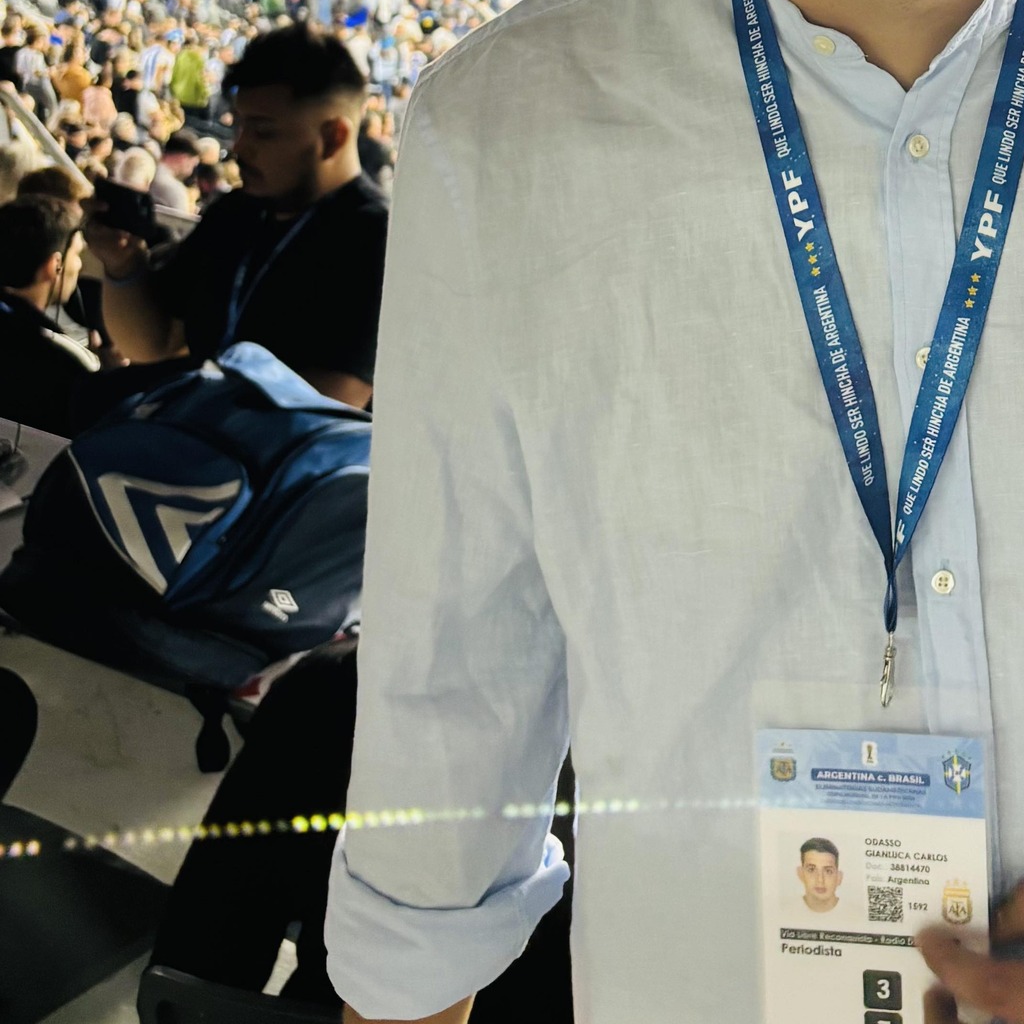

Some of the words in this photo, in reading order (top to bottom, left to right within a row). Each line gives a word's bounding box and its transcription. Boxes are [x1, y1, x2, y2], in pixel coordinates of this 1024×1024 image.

[748, 26, 762, 42] DE
[752, 40, 771, 83] HINCHA
[760, 81, 776, 104] SER
[766, 103, 785, 136] LINDO
[1005, 108, 1021, 130] SER
[774, 134, 792, 159] QUE
[998, 129, 1016, 162] LINDO
[992, 162, 1008, 185] QUE
[781, 169, 814, 242] YPF
[971, 189, 1004, 262] YPF
[813, 284, 841, 347] ARGENTINA
[829, 347, 846, 365] DE
[943, 317, 971, 380] ARGENTINA
[834, 363, 858, 408] HINCHA
[937, 377, 953, 395] DE
[847, 406, 864, 430] SER
[926, 395, 949, 438] HINCHA
[854, 429, 871, 464] LINDO
[921, 438, 937, 460] SER
[862, 462, 875, 486] QUE
[909, 459, 929, 494] LINDO
[902, 491, 917, 516] QUE
[816, 770, 875, 783] ARGENTINA
[888, 774, 925, 785] BRASIL
[864, 837, 902, 847] ODASSO
[865, 849, 911, 860] GIANLUCA
[913, 852, 948, 862] CARLOS
[887, 875, 930, 886] Argentina
[781, 942, 842, 957] Periodista
[876, 979, 891, 999] 3
